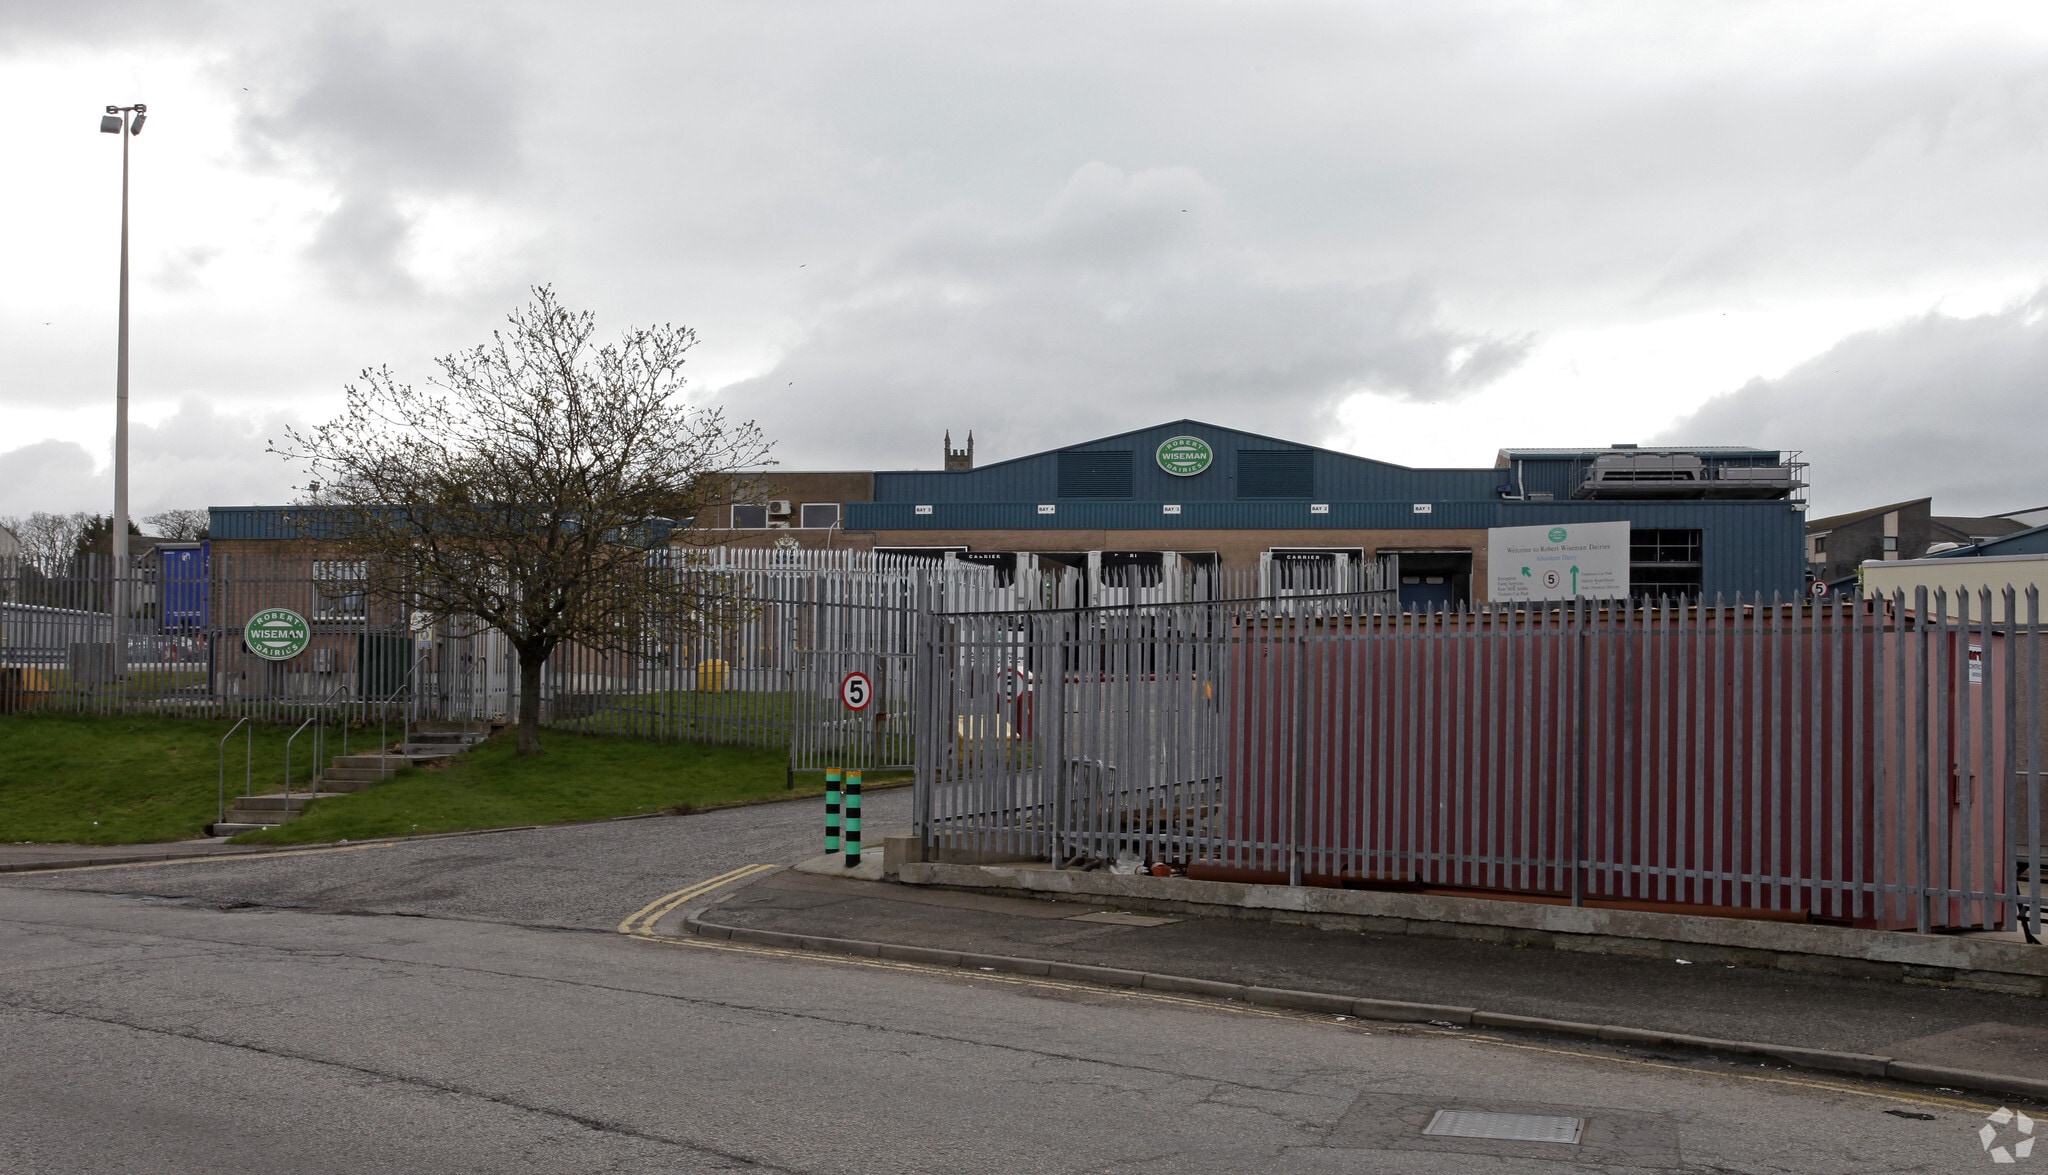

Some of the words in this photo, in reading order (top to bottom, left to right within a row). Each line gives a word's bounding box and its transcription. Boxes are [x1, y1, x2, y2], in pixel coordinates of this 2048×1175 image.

[1166, 440, 1203, 449] ROBERT
[1166, 463, 1202, 473] DAIRIES
[1548, 574, 1555, 584] 5
[1815, 584, 1824, 594] 5
[256, 612, 300, 625] ROBERT
[250, 630, 304, 638] WISEMAN
[256, 643, 298, 656] DAIRIES
[849, 680, 864, 704] 5
